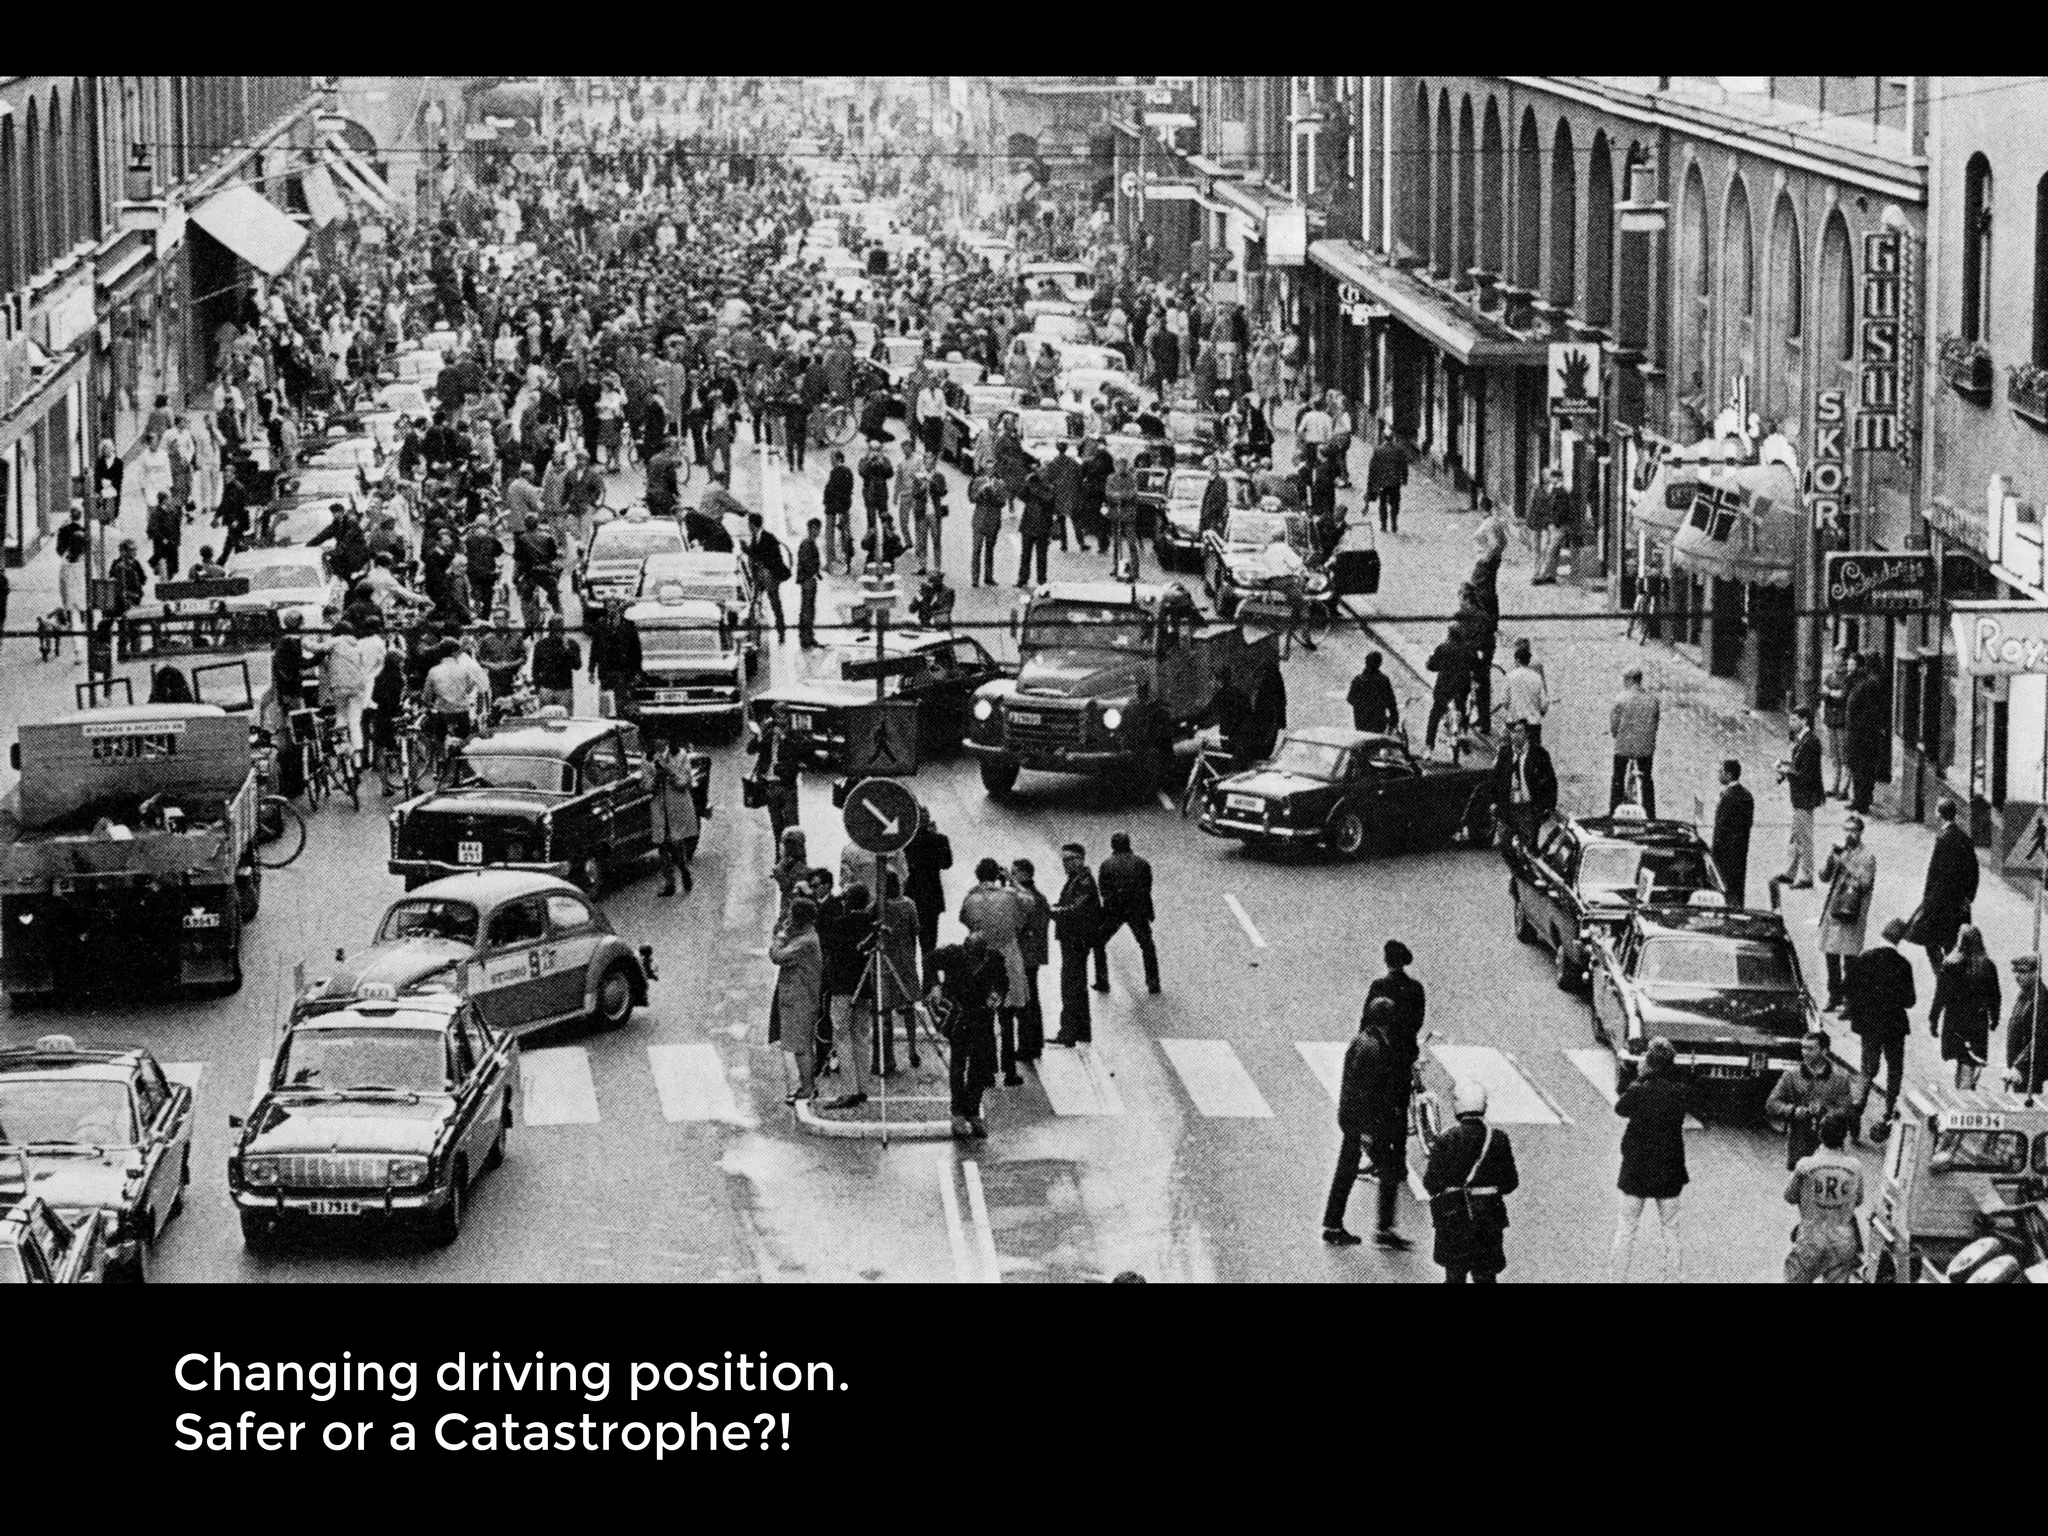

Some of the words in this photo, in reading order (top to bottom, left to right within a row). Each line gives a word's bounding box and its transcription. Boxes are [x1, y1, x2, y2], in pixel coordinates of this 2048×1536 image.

[1815, 391, 1842, 530] SKOR
[1972, 615, 2048, 670] Roy
[362, 986, 390, 999] TAXI
